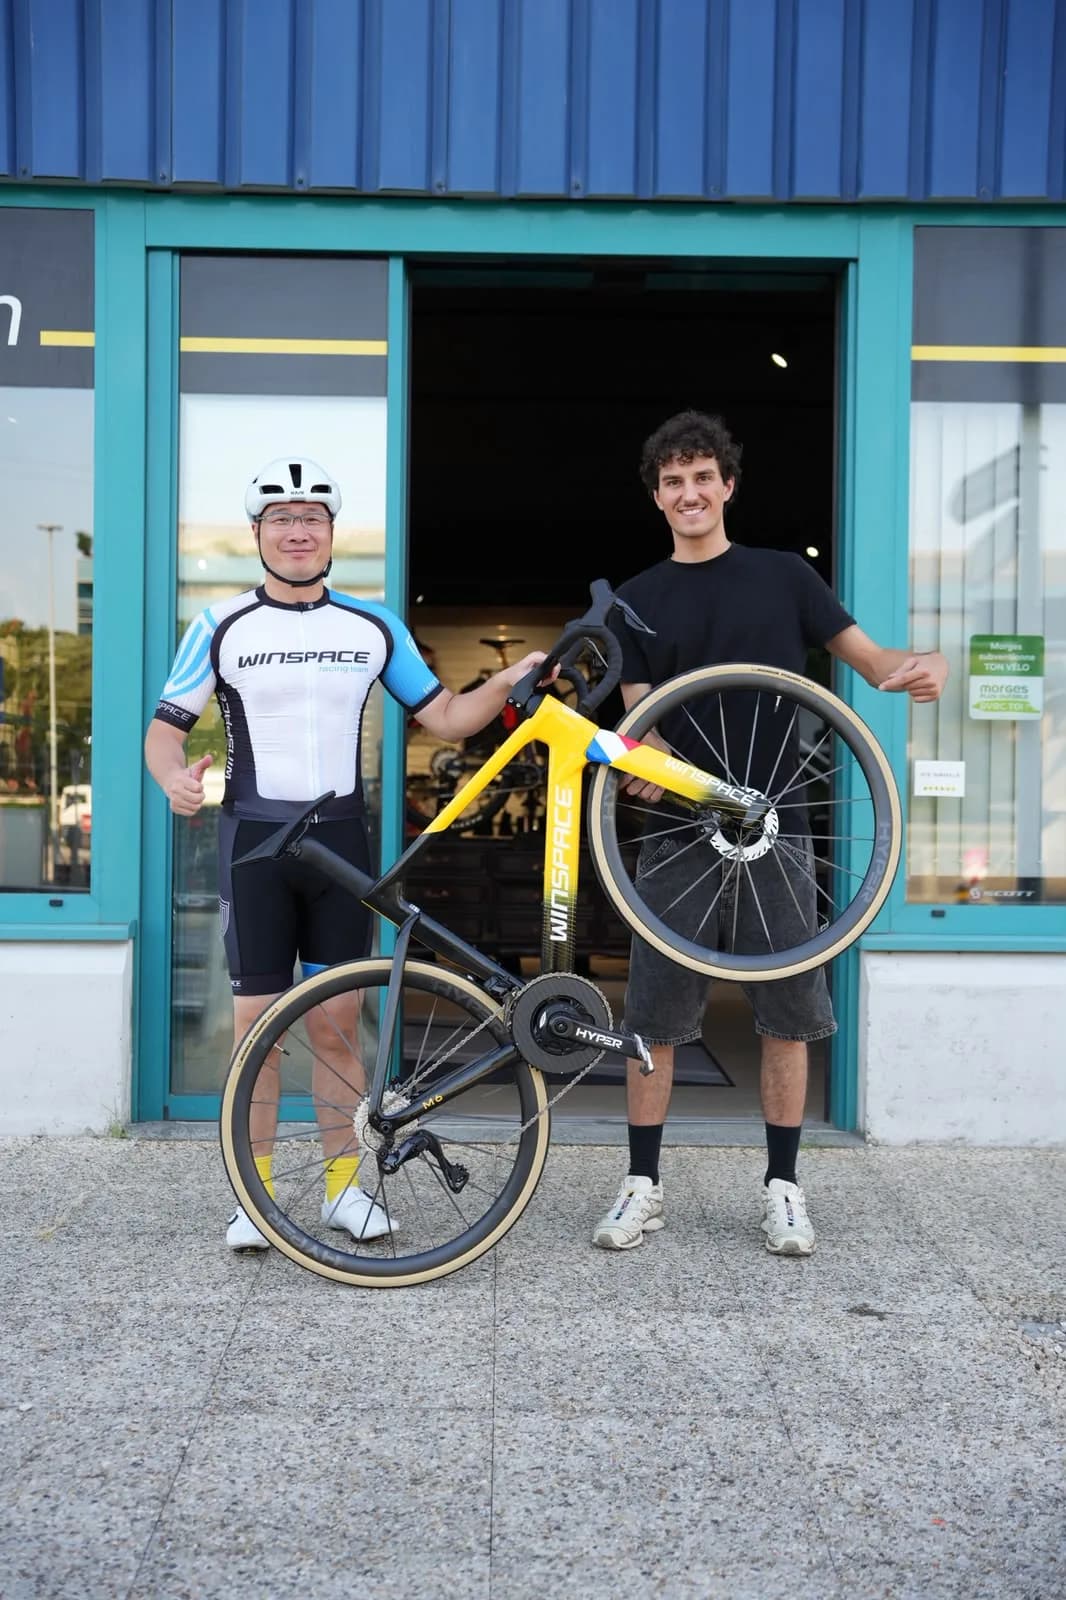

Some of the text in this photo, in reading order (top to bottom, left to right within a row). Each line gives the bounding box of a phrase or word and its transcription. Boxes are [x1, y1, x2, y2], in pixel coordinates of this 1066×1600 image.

[238, 651, 370, 669] WINSPACE
[320, 665, 369, 673] racing team
[665, 757, 757, 807] WINSPACE
[550, 784, 574, 942] WINSPACE
[575, 1027, 623, 1049] HYPER
[422, 1095, 443, 1109] M6
